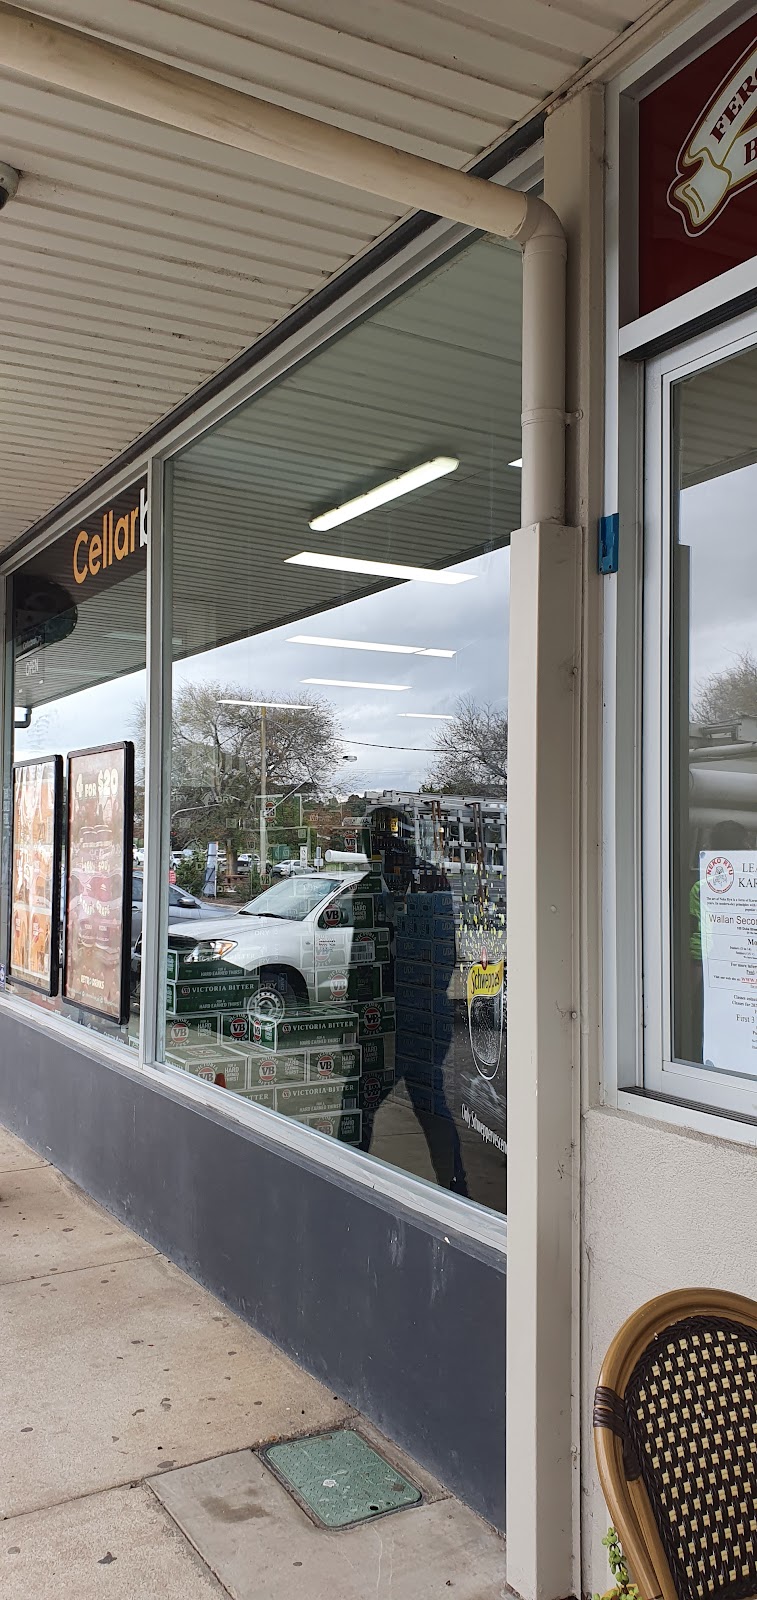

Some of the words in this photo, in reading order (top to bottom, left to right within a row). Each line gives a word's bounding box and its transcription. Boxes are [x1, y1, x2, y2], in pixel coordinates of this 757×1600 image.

[709, 68, 757, 144] FER
[76, 773, 84, 798] 4
[84, 782, 97, 798] FOR
[97, 768, 119, 797] $20
[742, 863, 757, 873] LE
[325, 910, 340, 920] VB
[709, 914, 735, 924] Wallan
[470, 968, 500, 995] Schweppes
[192, 985, 227, 993] VICTORIA
[228, 983, 255, 991] BITTER
[736, 1013, 750, 1023] First
[233, 1023, 246, 1032] VB
[293, 1022, 327, 1031] VICTORIA
[328, 1020, 354, 1029] BITTER
[173, 1028, 187, 1038] VB
[319, 1061, 332, 1070] VB
[261, 1066, 275, 1076] VB
[292, 1088, 327, 1097] VICTORIA
[328, 1084, 354, 1093] BITTER
